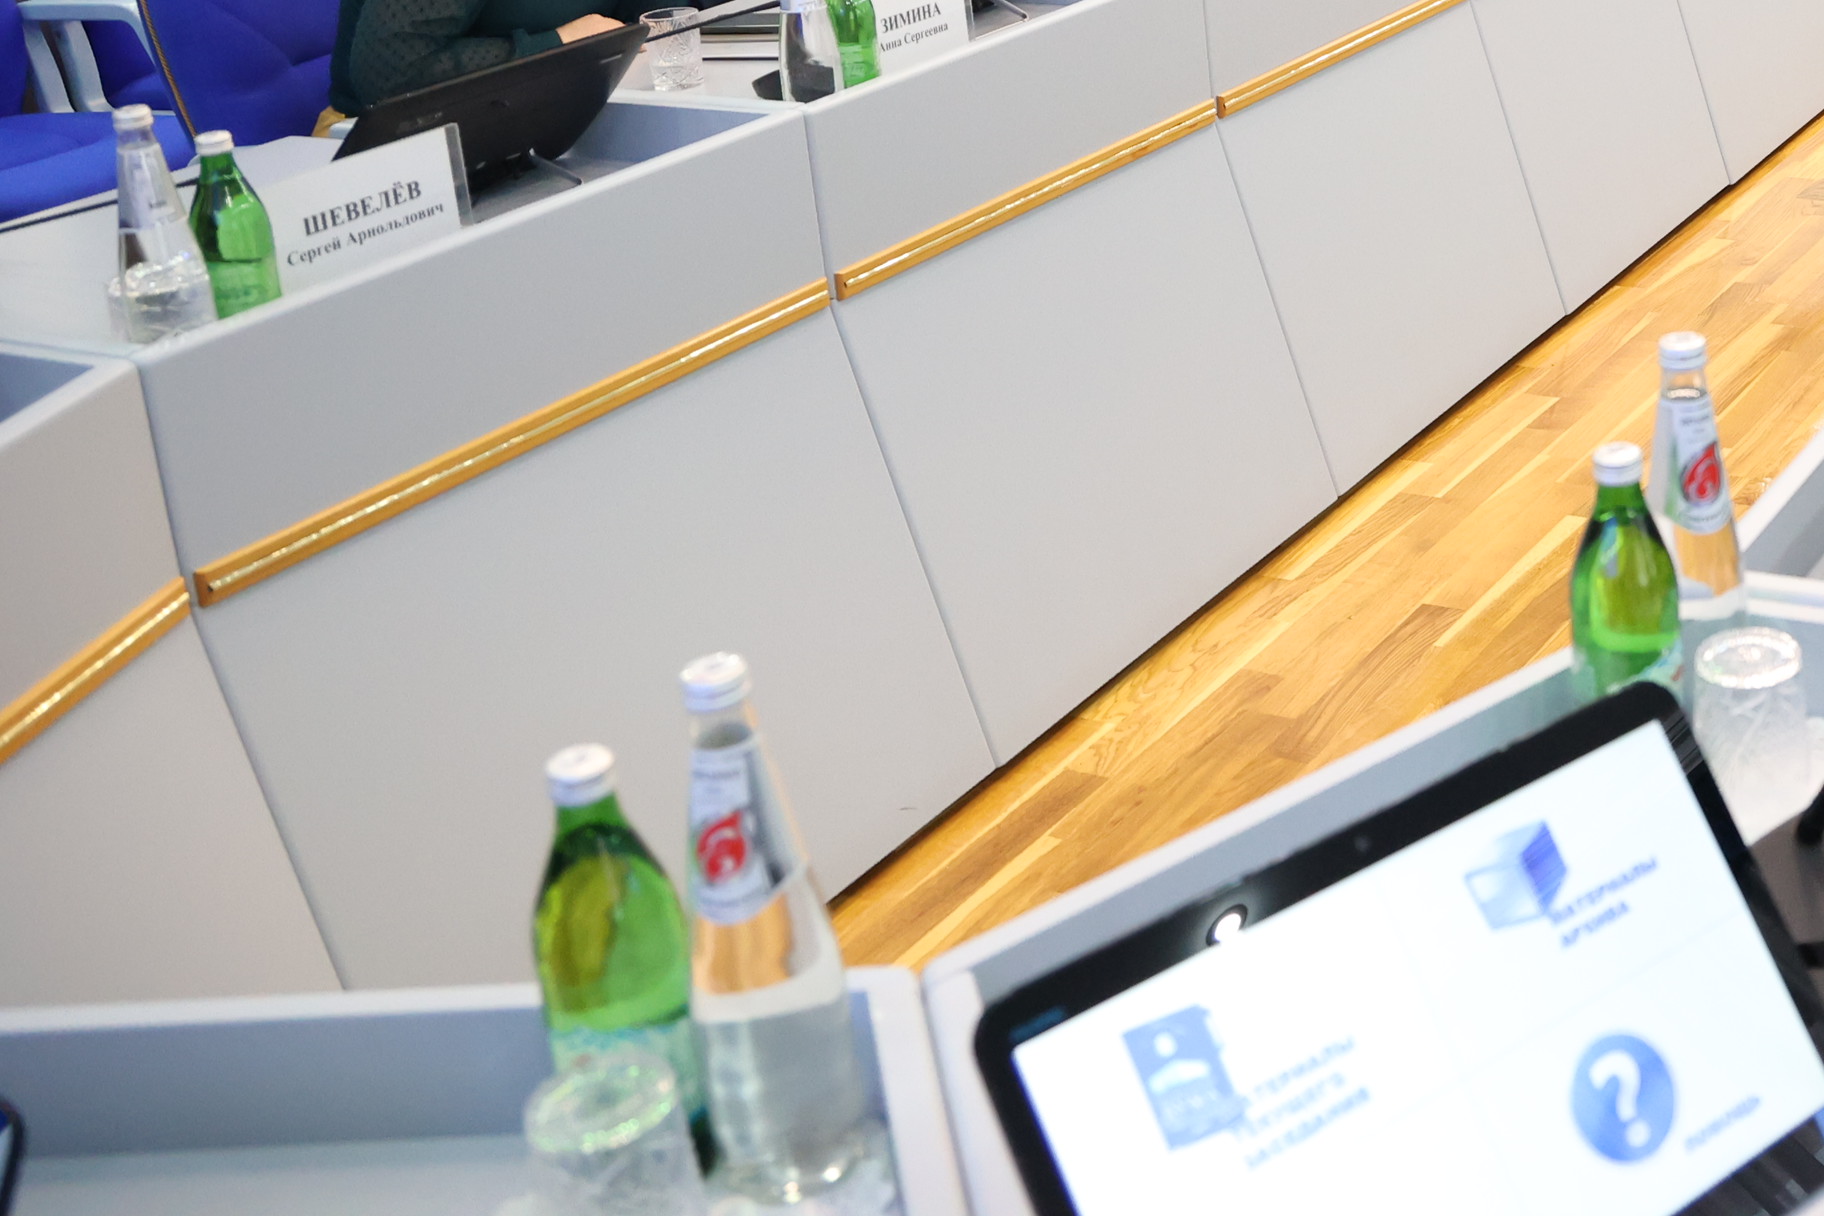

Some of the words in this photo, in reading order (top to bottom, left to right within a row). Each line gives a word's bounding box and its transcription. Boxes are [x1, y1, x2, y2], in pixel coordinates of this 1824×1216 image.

[880, 2, 942, 34] ЗИМИНА
[904, 22, 949, 46] Сергеевна
[303, 180, 422, 237] ШЕВЕЛЁВ
[287, 238, 342, 266] Сергей
[346, 202, 445, 246] Арнольдович
